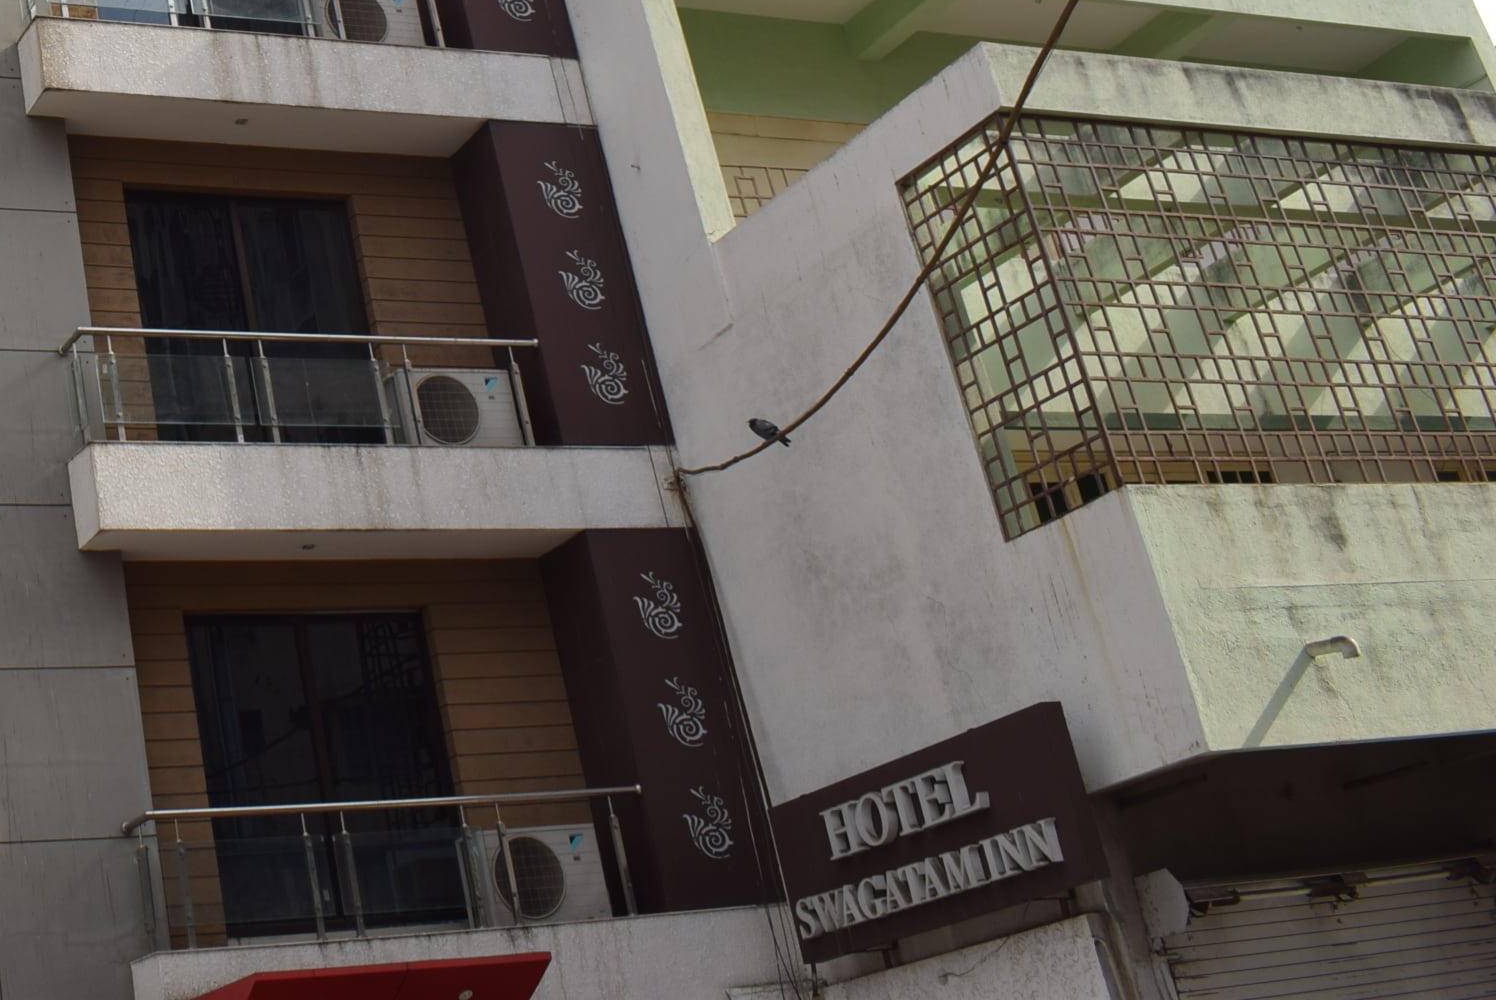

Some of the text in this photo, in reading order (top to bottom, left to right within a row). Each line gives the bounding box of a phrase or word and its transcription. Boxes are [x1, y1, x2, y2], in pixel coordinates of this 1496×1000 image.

[819, 761, 990, 860] HOTEL
[796, 818, 1064, 939] SWAGATAM INN
